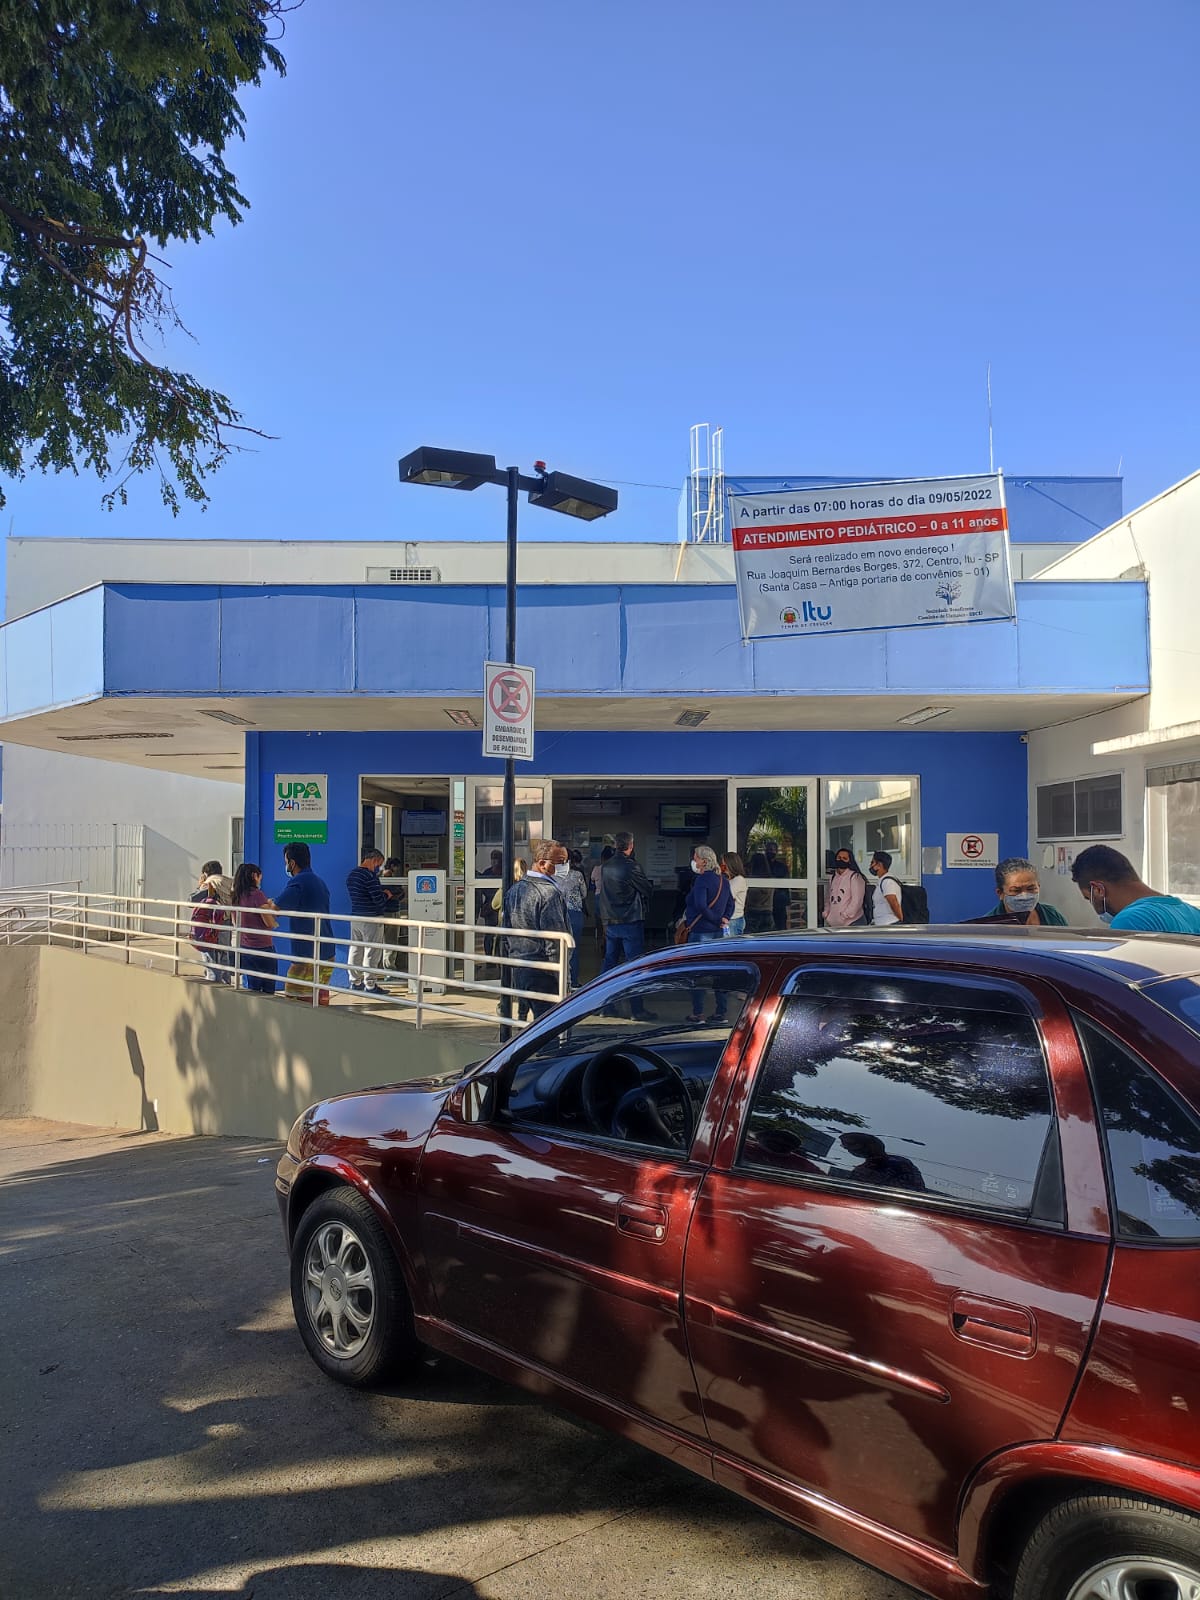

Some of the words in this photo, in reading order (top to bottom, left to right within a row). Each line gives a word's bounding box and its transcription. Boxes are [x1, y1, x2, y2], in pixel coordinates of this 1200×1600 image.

[740, 507, 750, 518] A
[752, 505, 786, 519] partir
[789, 503, 810, 515] das
[813, 500, 846, 513] 07:00
[850, 497, 884, 510] horas
[888, 496, 904, 507] do
[907, 494, 926, 506] dia
[928, 489, 992, 504] 09/05/2022
[742, 528, 835, 545] ATENDIMENTO
[838, 521, 917, 538] PEDIÁTRICO
[930, 520, 938, 531] 0
[941, 522, 949, 530] a
[952, 518, 964, 529] 11
[968, 516, 999, 528] anos
[789, 554, 812, 565] Será
[814, 551, 858, 563] realizado
[860, 550, 876, 559] em
[878, 548, 902, 559] novo
[904, 544, 949, 556] endereço
[746, 570, 767, 581] Rua
[769, 568, 809, 581] Joaquim
[811, 564, 861, 577] Bernardes
[926, 556, 963, 568] Centro,
[964, 554, 976, 564] Itu
[984, 552, 1000, 563] SP
[759, 583, 790, 595] (Santa
[792, 581, 818, 592] Casa
[828, 578, 859, 589] Antiga
[861, 574, 898, 587] portaria
[900, 572, 912, 583] de
[914, 568, 963, 582] convênios
[973, 566, 990, 578] 01)
[802, 600, 832, 622] Itu
[492, 734, 527, 744] DESEMBARQUE
[495, 725, 522, 734] EMBARQUE
[277, 782, 322, 799] UPA
[278, 799, 300, 811] 24h
